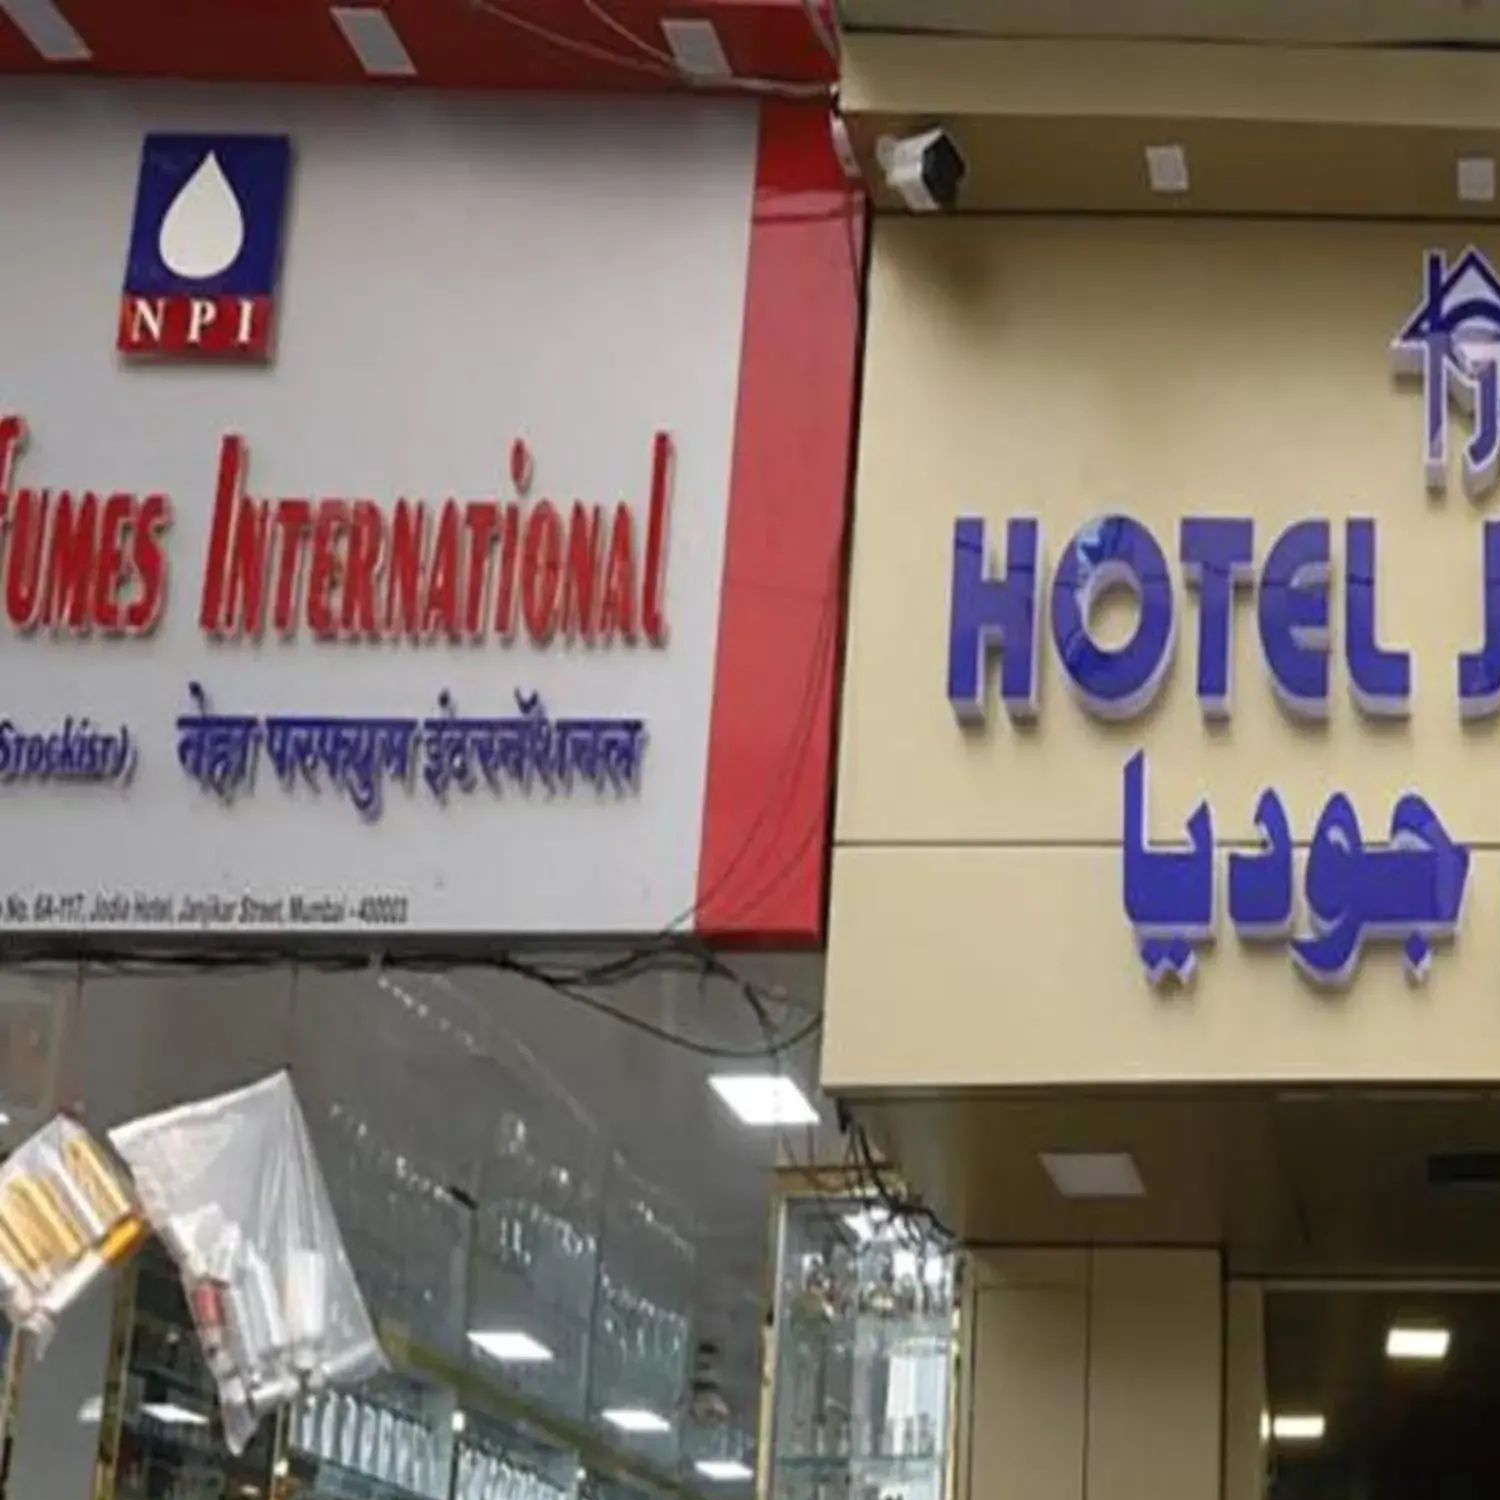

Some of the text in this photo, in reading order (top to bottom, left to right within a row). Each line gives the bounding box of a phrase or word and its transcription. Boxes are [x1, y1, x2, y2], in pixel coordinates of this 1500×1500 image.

[129, 299, 256, 342] NPI
[946, 514, 1412, 724] HOTEL
[1122, 746, 1473, 986] جوديا
